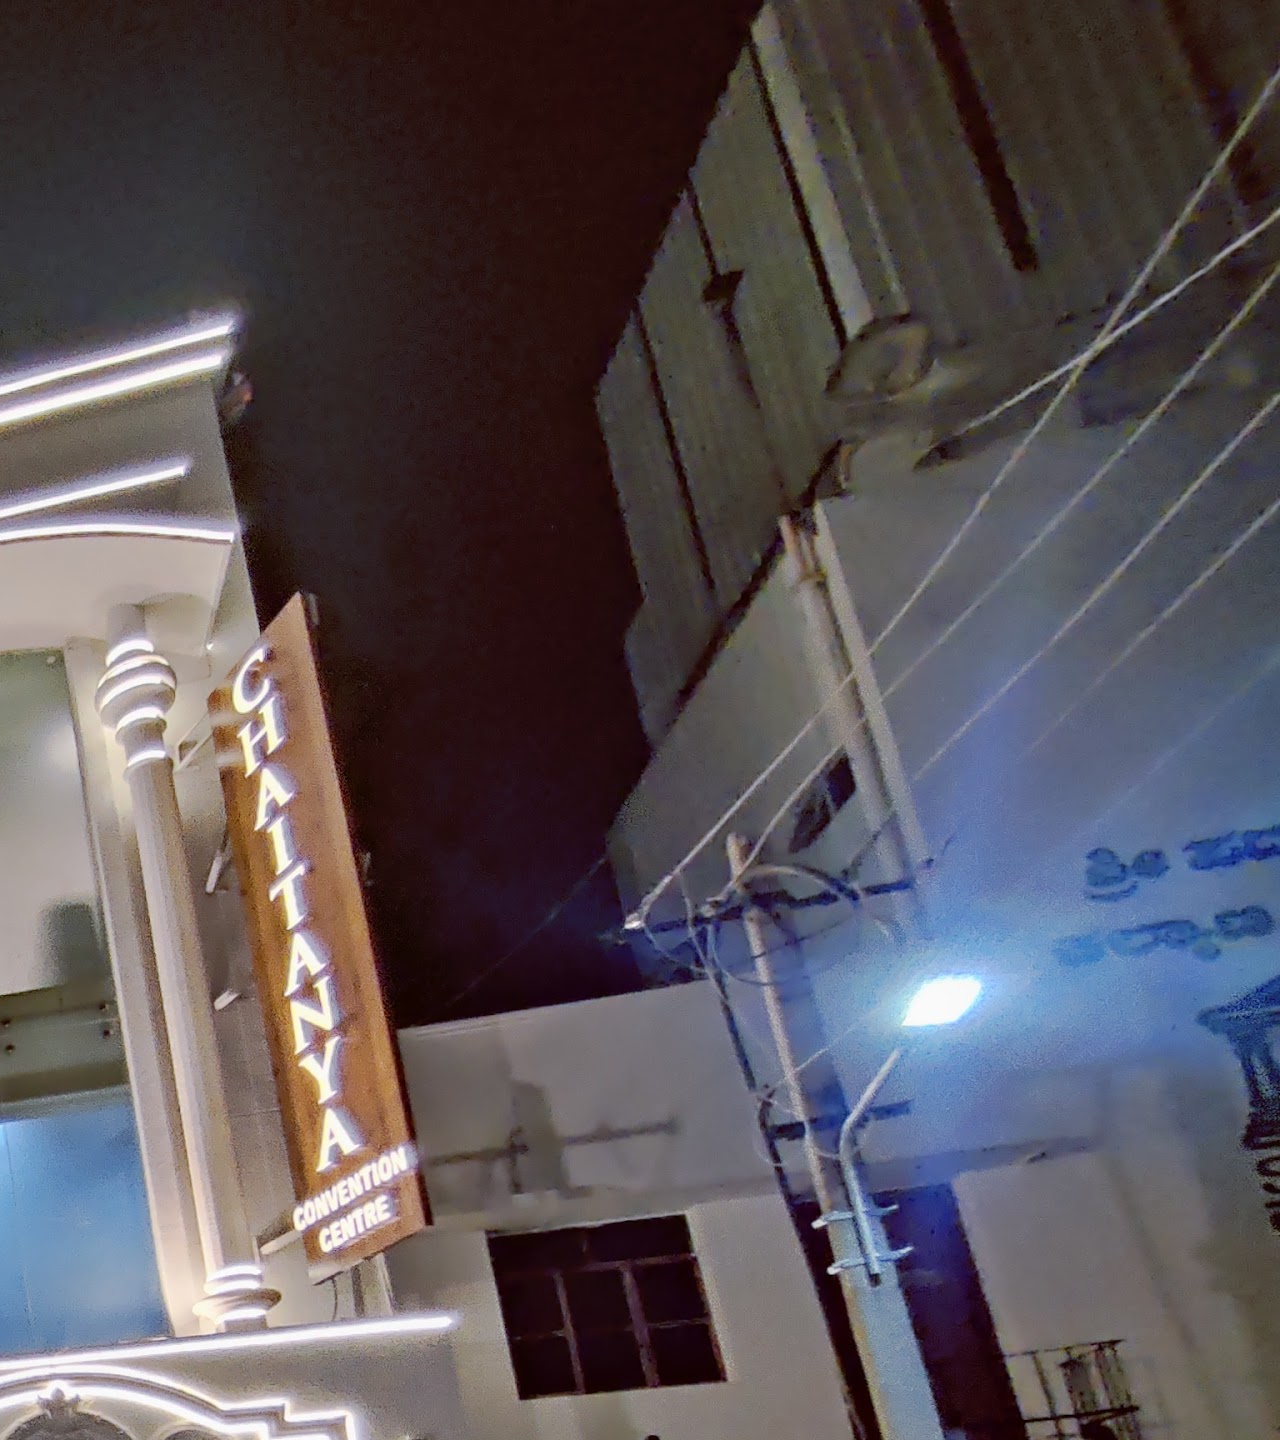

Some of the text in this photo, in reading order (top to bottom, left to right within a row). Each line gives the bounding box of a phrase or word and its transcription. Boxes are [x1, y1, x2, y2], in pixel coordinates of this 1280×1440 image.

[232, 643, 361, 1172] CHAITANYA
[292, 1146, 409, 1232] CONVENTION
[319, 1194, 392, 1253] CENTRE
